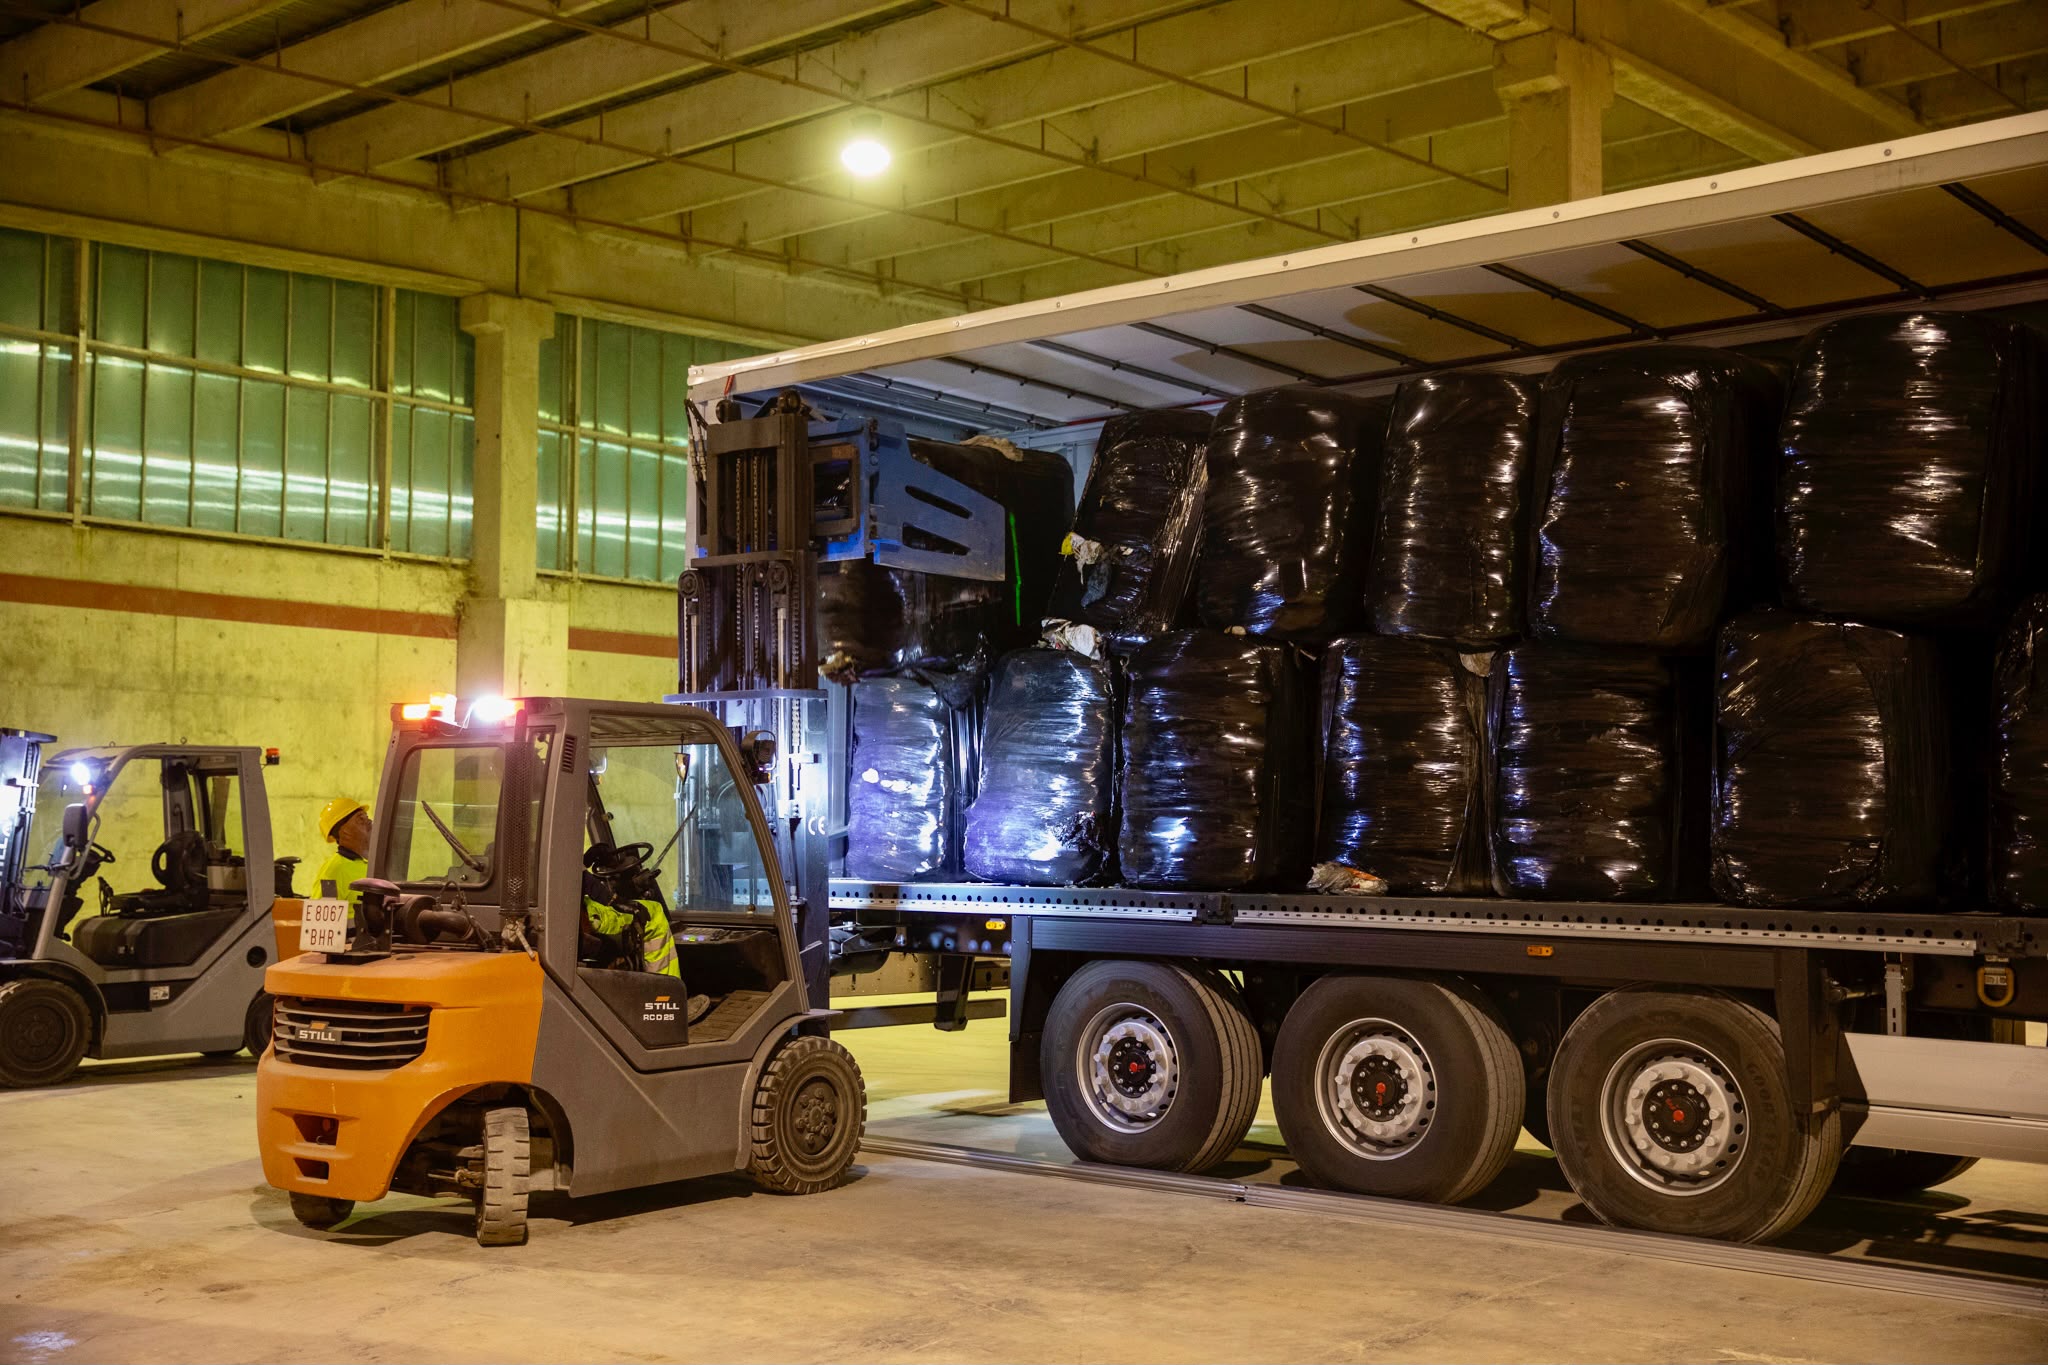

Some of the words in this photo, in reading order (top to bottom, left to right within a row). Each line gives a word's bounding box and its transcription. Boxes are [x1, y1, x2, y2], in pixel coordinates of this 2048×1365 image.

[306, 905, 312, 921] E
[315, 905, 344, 921] 8067
[310, 929, 334, 946] BHR
[645, 1002, 680, 1010] STILL
[299, 1030, 336, 1041] STILL
